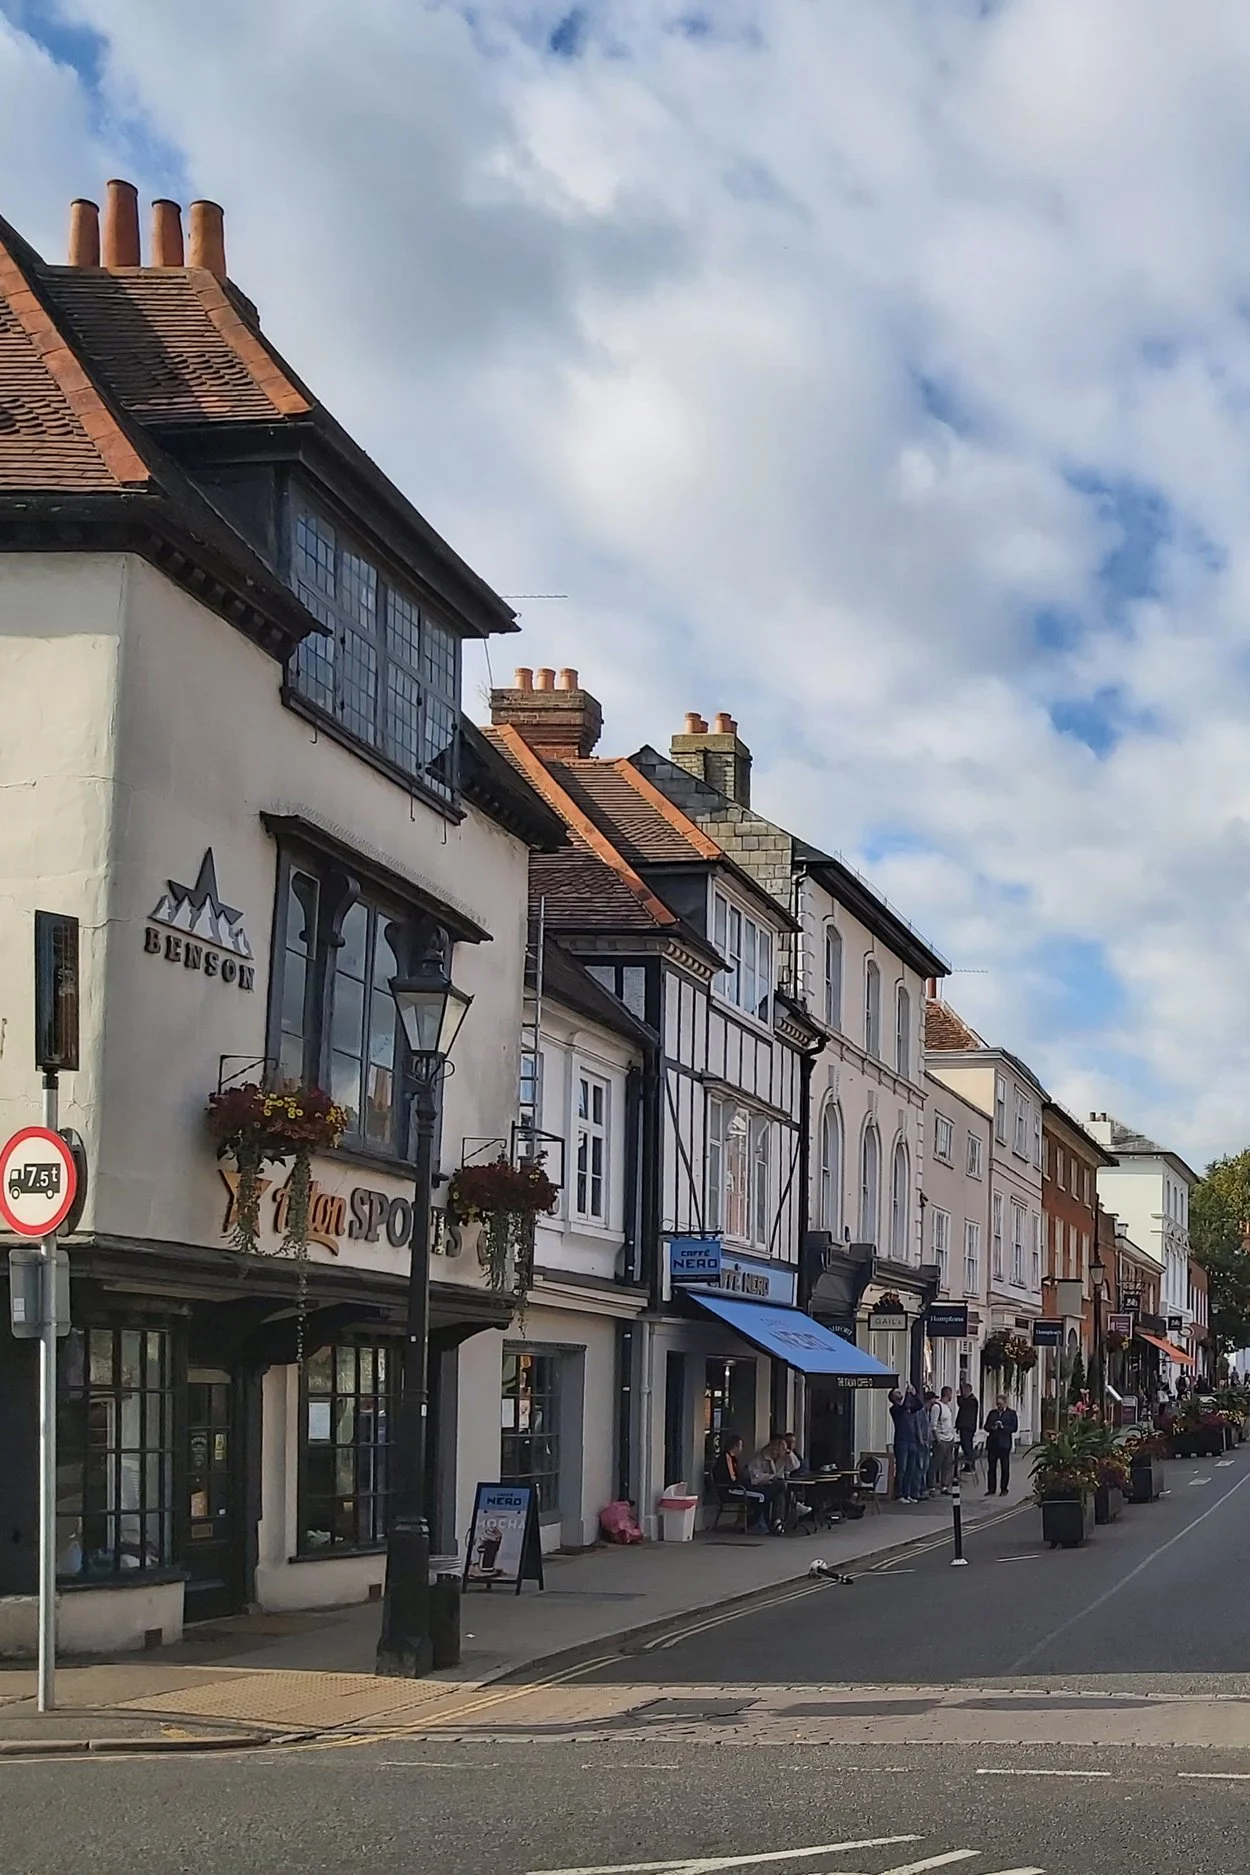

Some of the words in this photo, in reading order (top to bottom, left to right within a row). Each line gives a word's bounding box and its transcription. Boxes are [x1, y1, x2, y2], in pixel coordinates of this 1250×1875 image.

[144, 926, 255, 991] BENSON
[674, 1259, 718, 1269] NERO
[486, 1496, 522, 1506] NERO
